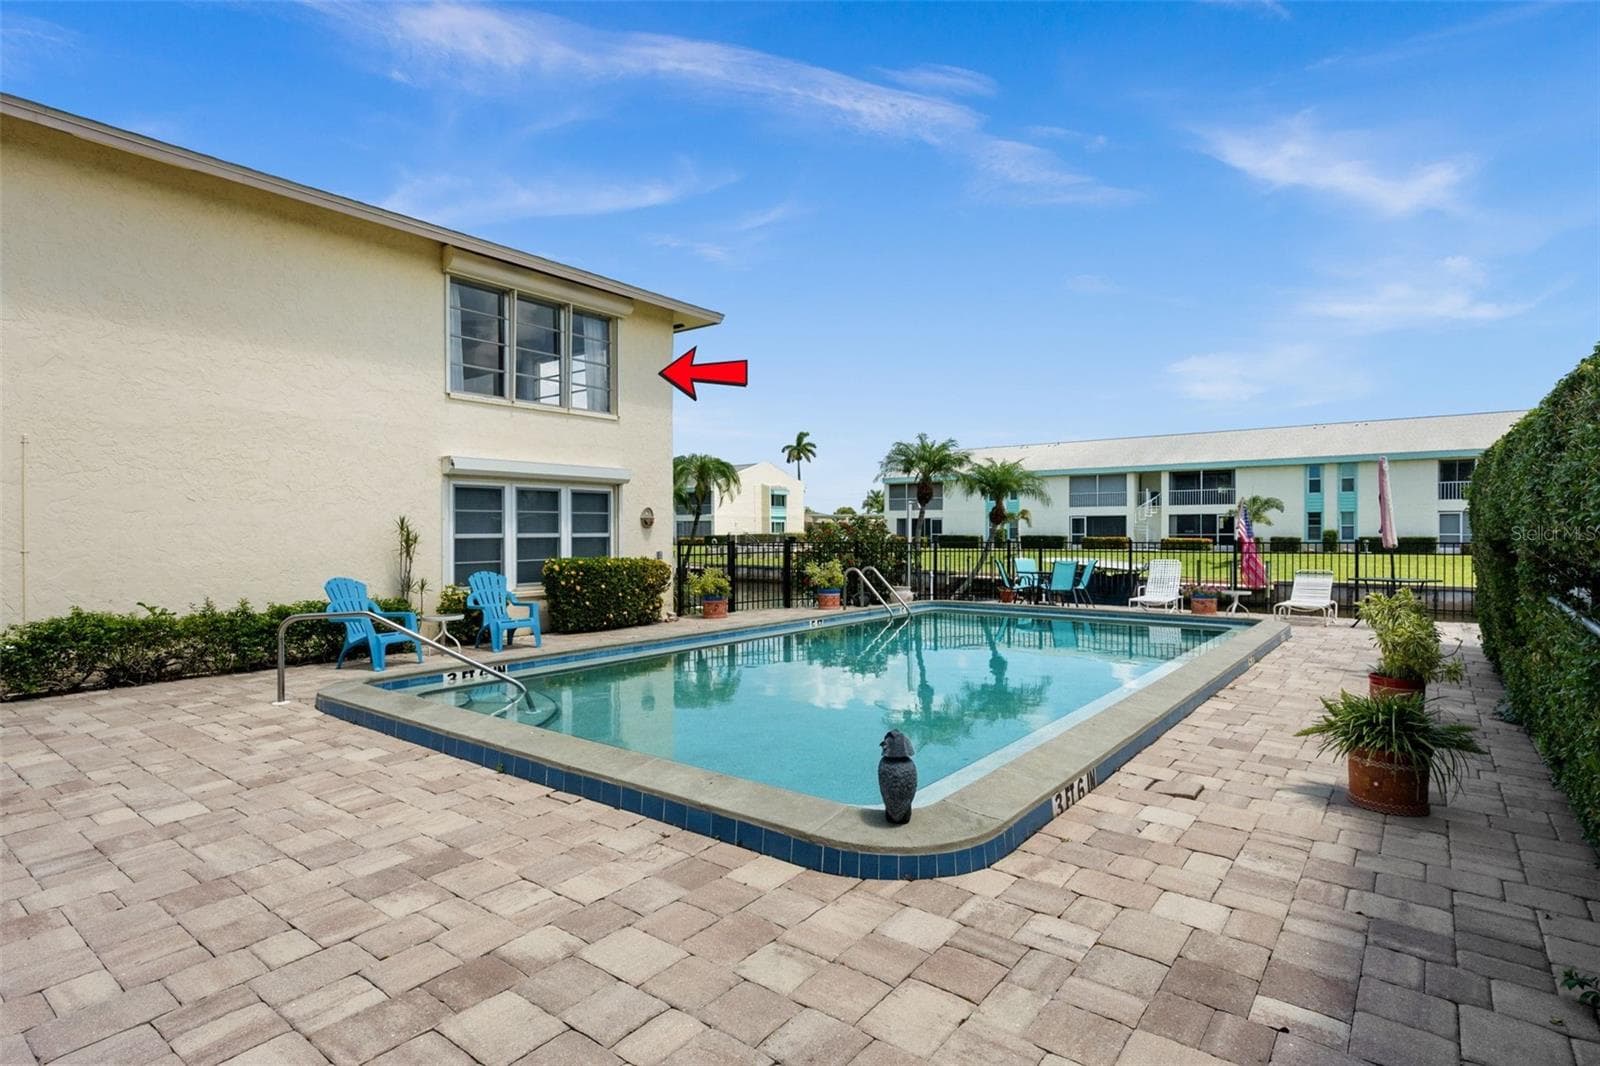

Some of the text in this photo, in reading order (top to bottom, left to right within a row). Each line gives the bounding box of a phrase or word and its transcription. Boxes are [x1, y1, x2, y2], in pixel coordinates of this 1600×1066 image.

[1055, 768, 1096, 817] 3 FT 6 IN
